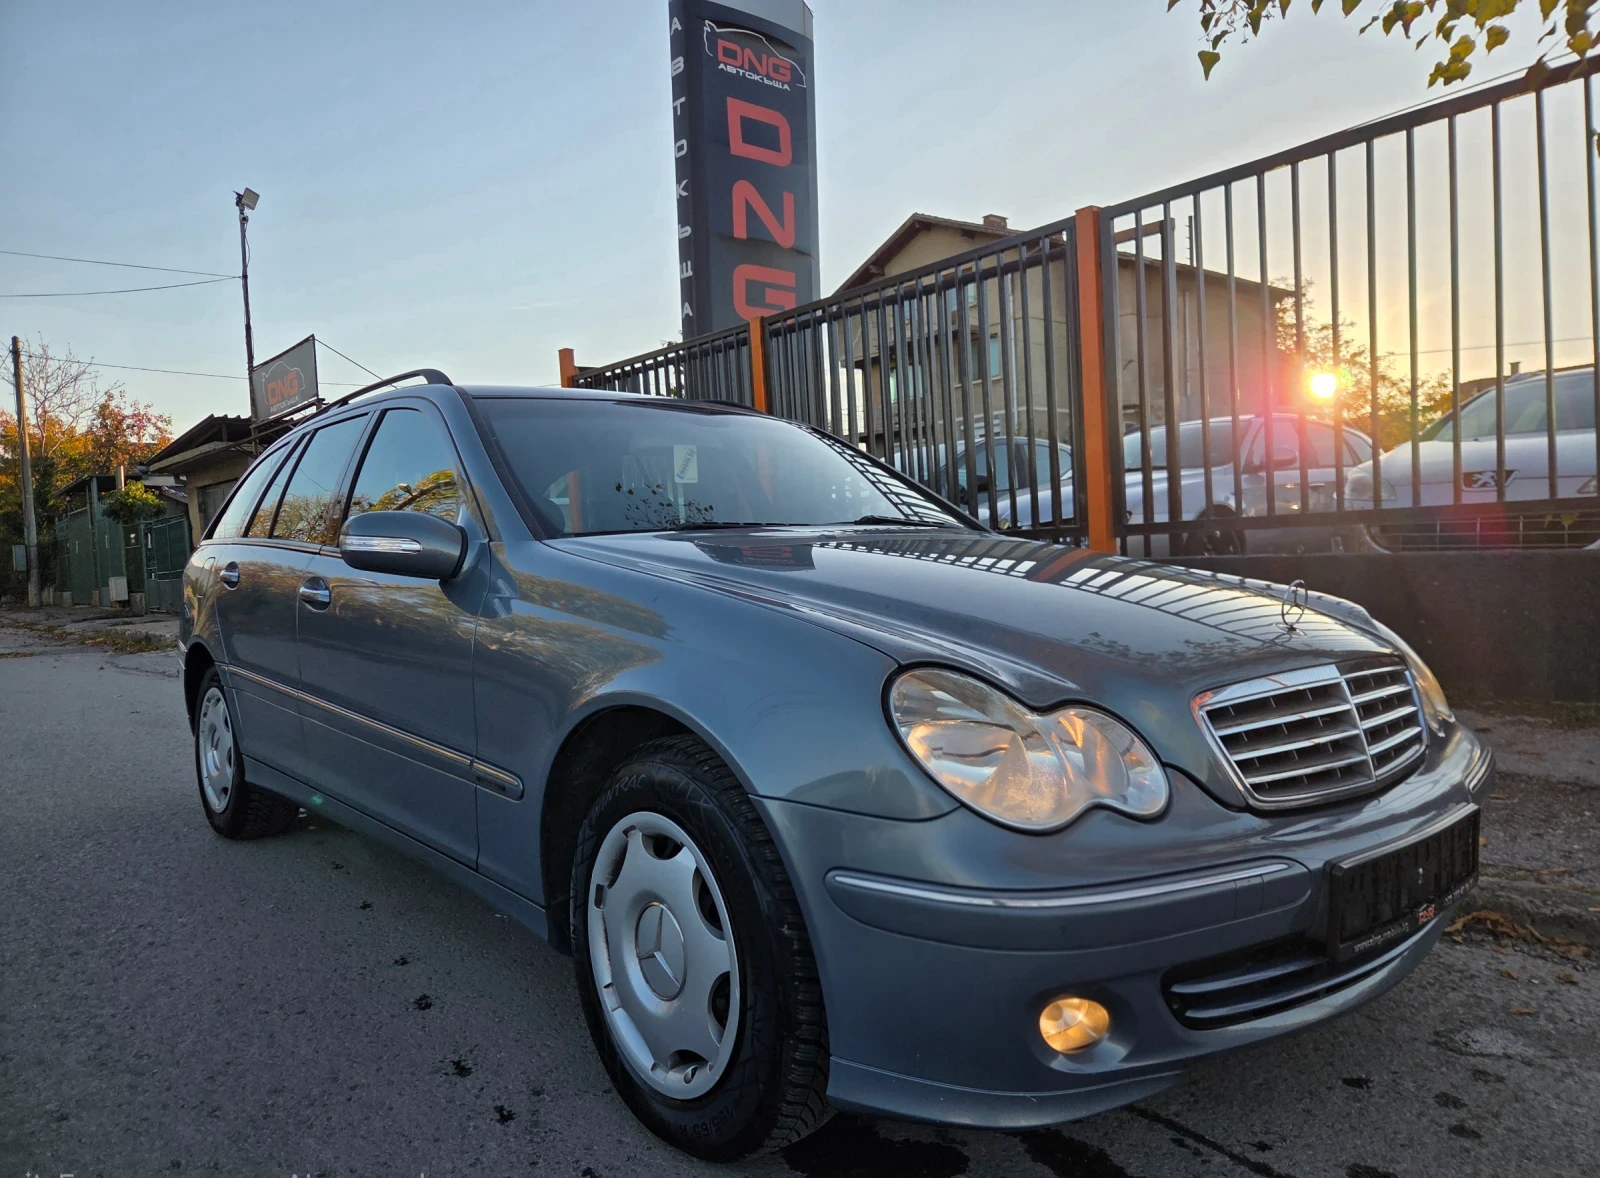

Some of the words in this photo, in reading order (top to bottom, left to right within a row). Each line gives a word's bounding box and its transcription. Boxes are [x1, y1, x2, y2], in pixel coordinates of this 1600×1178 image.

[717, 38, 791, 83] DNG
[718, 63, 791, 91] АВТОКЪЩА
[726, 96, 797, 322] DNG
[268, 370, 298, 406] DNG
